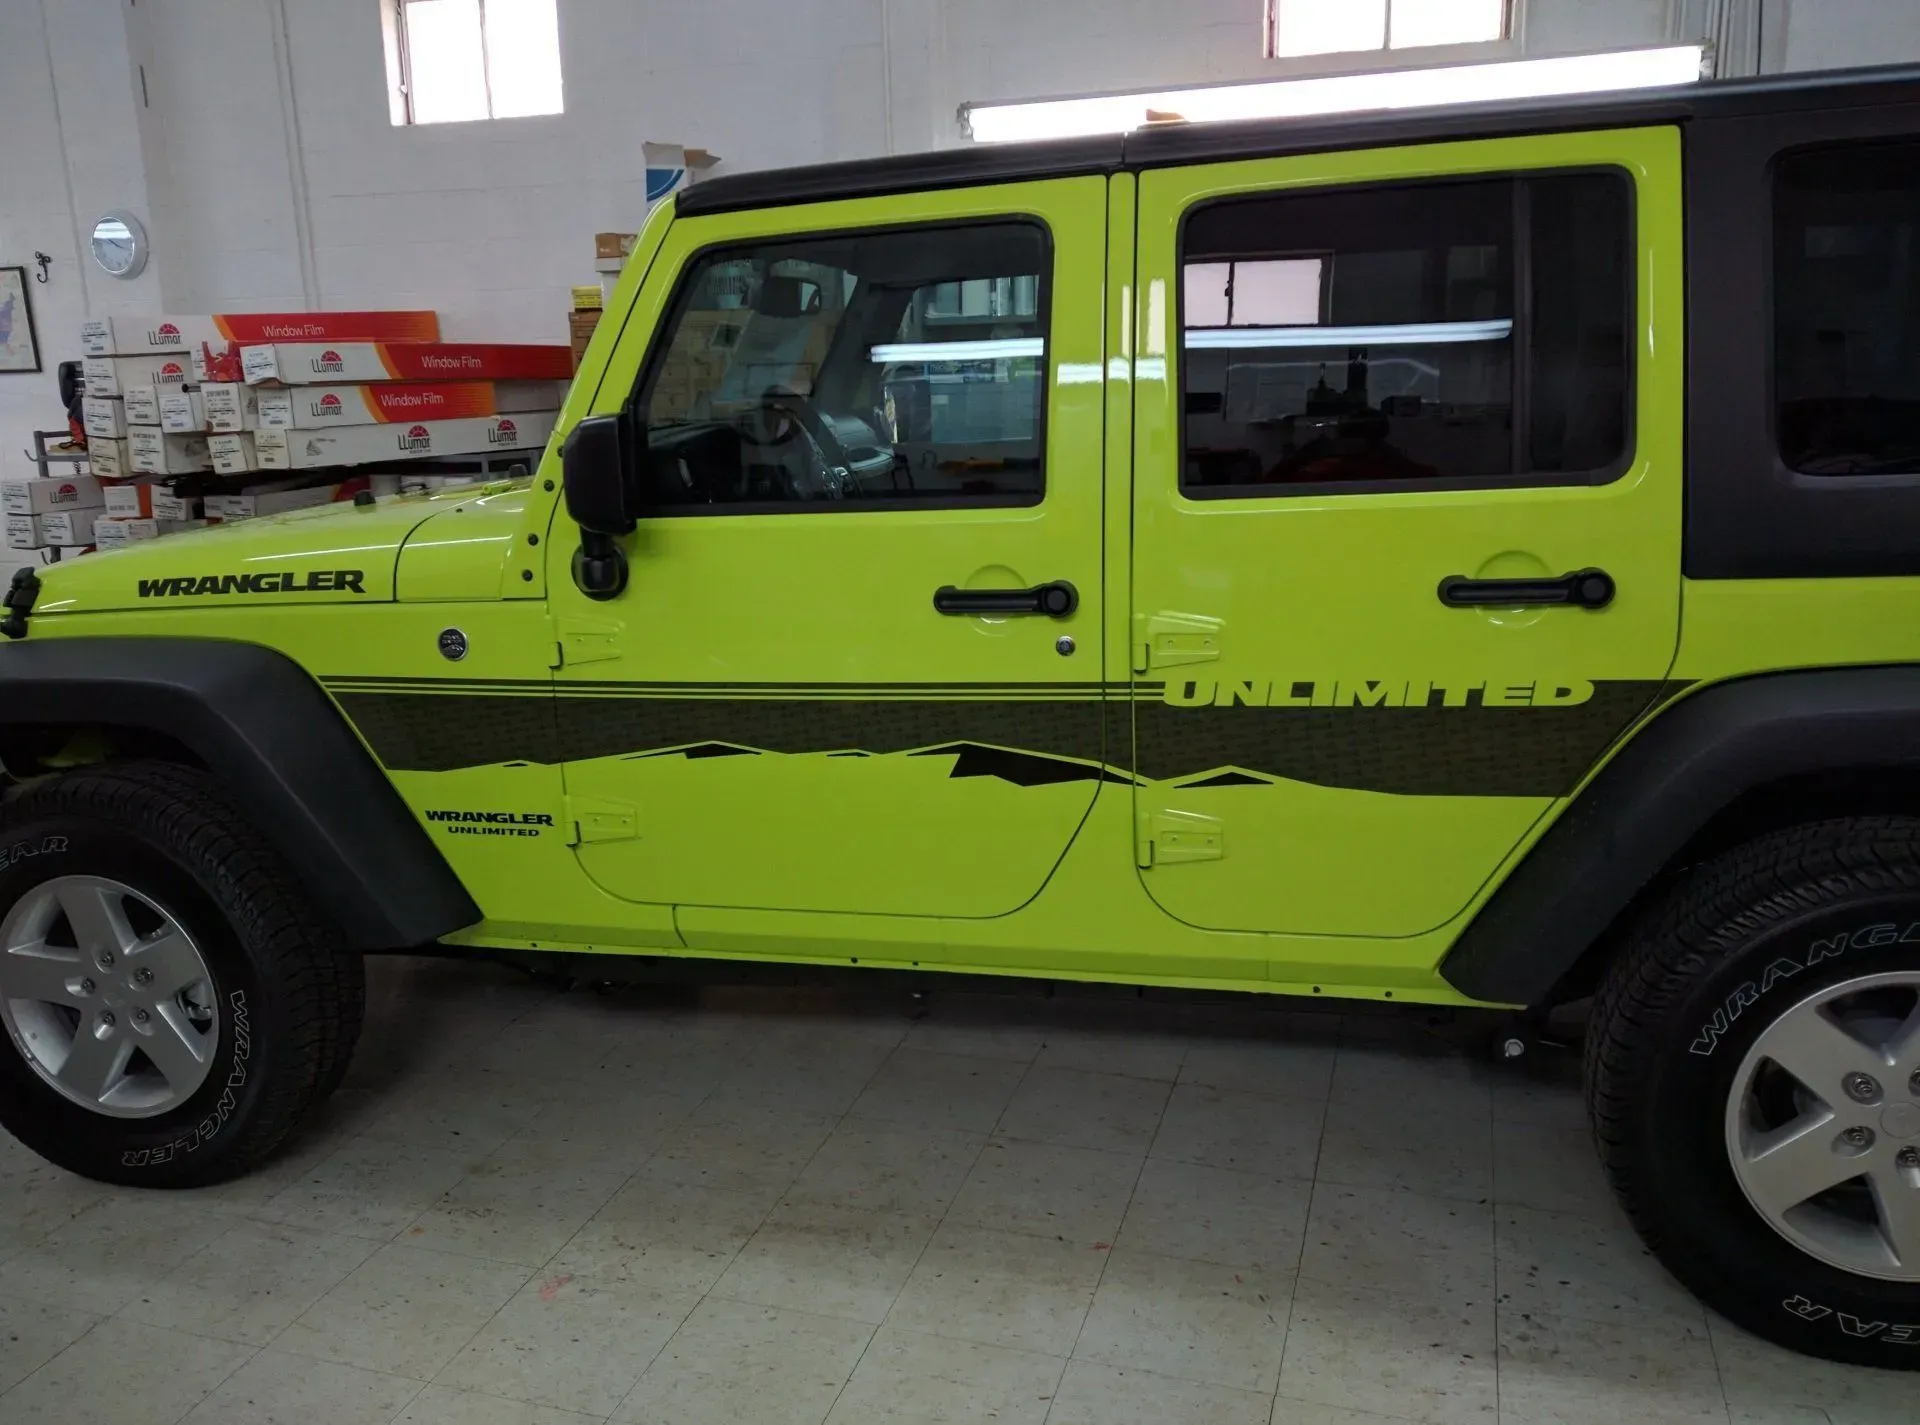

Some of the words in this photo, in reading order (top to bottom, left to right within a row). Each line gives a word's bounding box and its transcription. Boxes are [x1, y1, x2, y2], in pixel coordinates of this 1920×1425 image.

[262, 324, 303, 337] Window
[303, 323, 325, 336] Film
[421, 355, 461, 369] Window
[461, 355, 482, 368] Film
[380, 393, 422, 407] Window
[422, 392, 444, 405] Film
[138, 570, 367, 598] WRANGLER
[1163, 680, 1595, 707] UNLIMITED
[425, 809, 554, 827] WRANGLER
[447, 825, 540, 837] UNLIMITED
[121, 990, 251, 1166] WRANGLER
